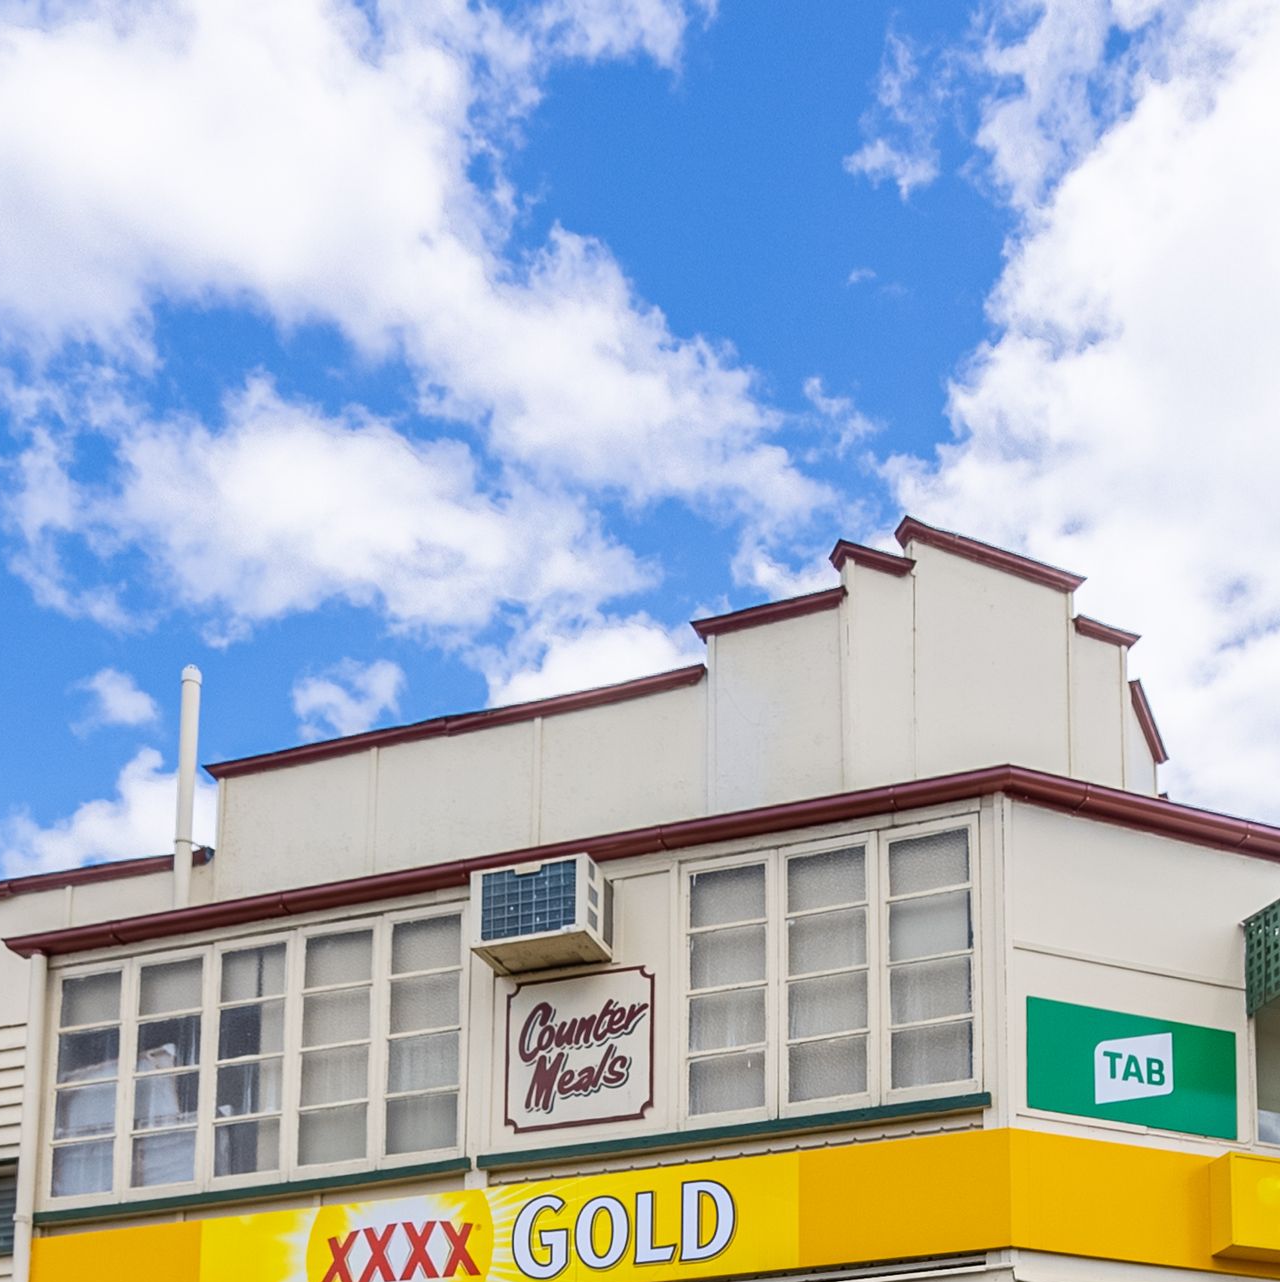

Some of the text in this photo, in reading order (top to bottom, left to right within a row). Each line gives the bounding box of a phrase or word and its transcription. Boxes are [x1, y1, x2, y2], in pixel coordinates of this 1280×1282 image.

[518, 999, 649, 1065] Counter
[524, 1044, 632, 1114] Meals
[1103, 1051, 1165, 1086] TAB
[511, 1180, 736, 1281] GOLD
